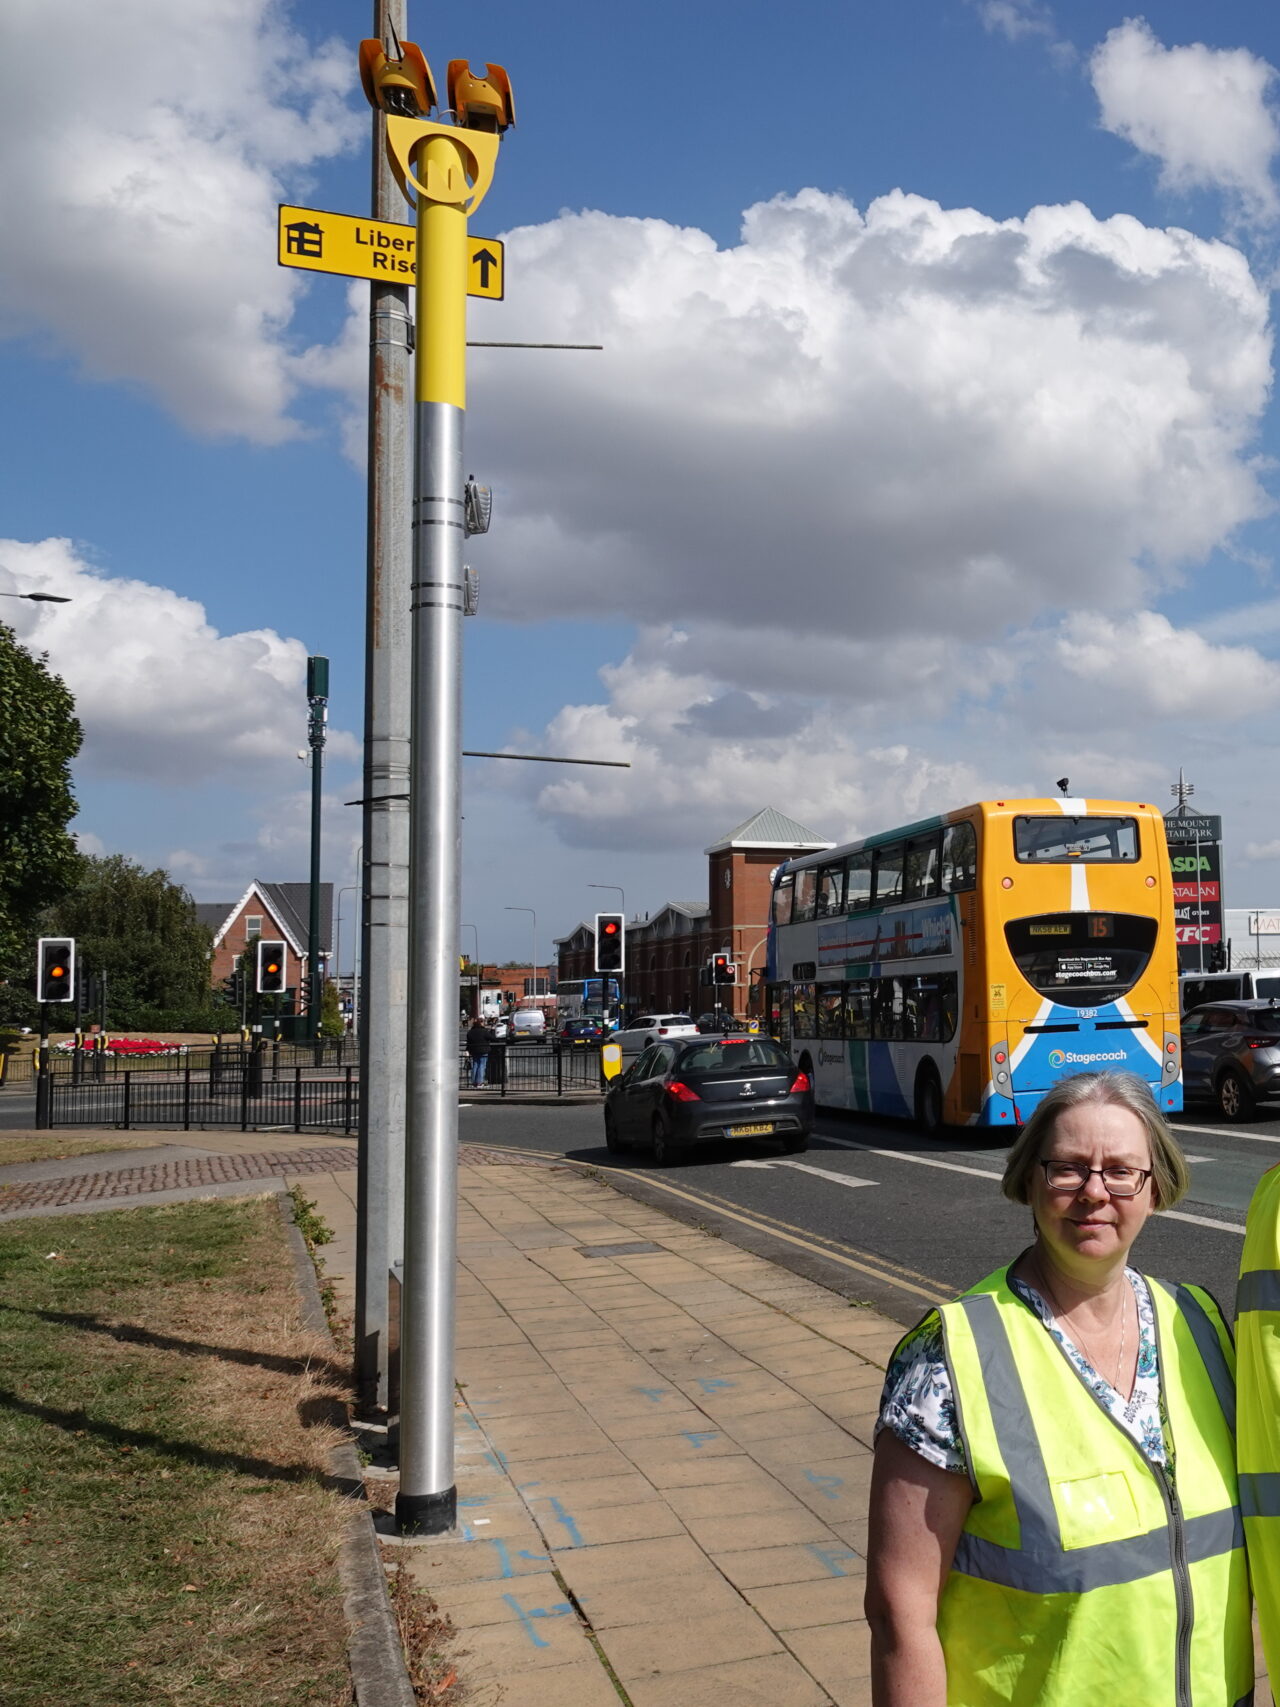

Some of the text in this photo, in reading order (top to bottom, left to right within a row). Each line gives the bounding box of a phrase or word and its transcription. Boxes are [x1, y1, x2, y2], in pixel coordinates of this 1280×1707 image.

[355, 227, 415, 252] Liber
[1164, 819, 1211, 828] HE MOUNT
[1190, 829, 1213, 838] PARK
[1172, 886, 1215, 897] ATALAN
[1093, 917, 1108, 937] 15
[1055, 970, 1117, 979] stagecoachbus.com
[1077, 1009, 1098, 1018] 19382
[1066, 1049, 1127, 1065] Stagecoach
